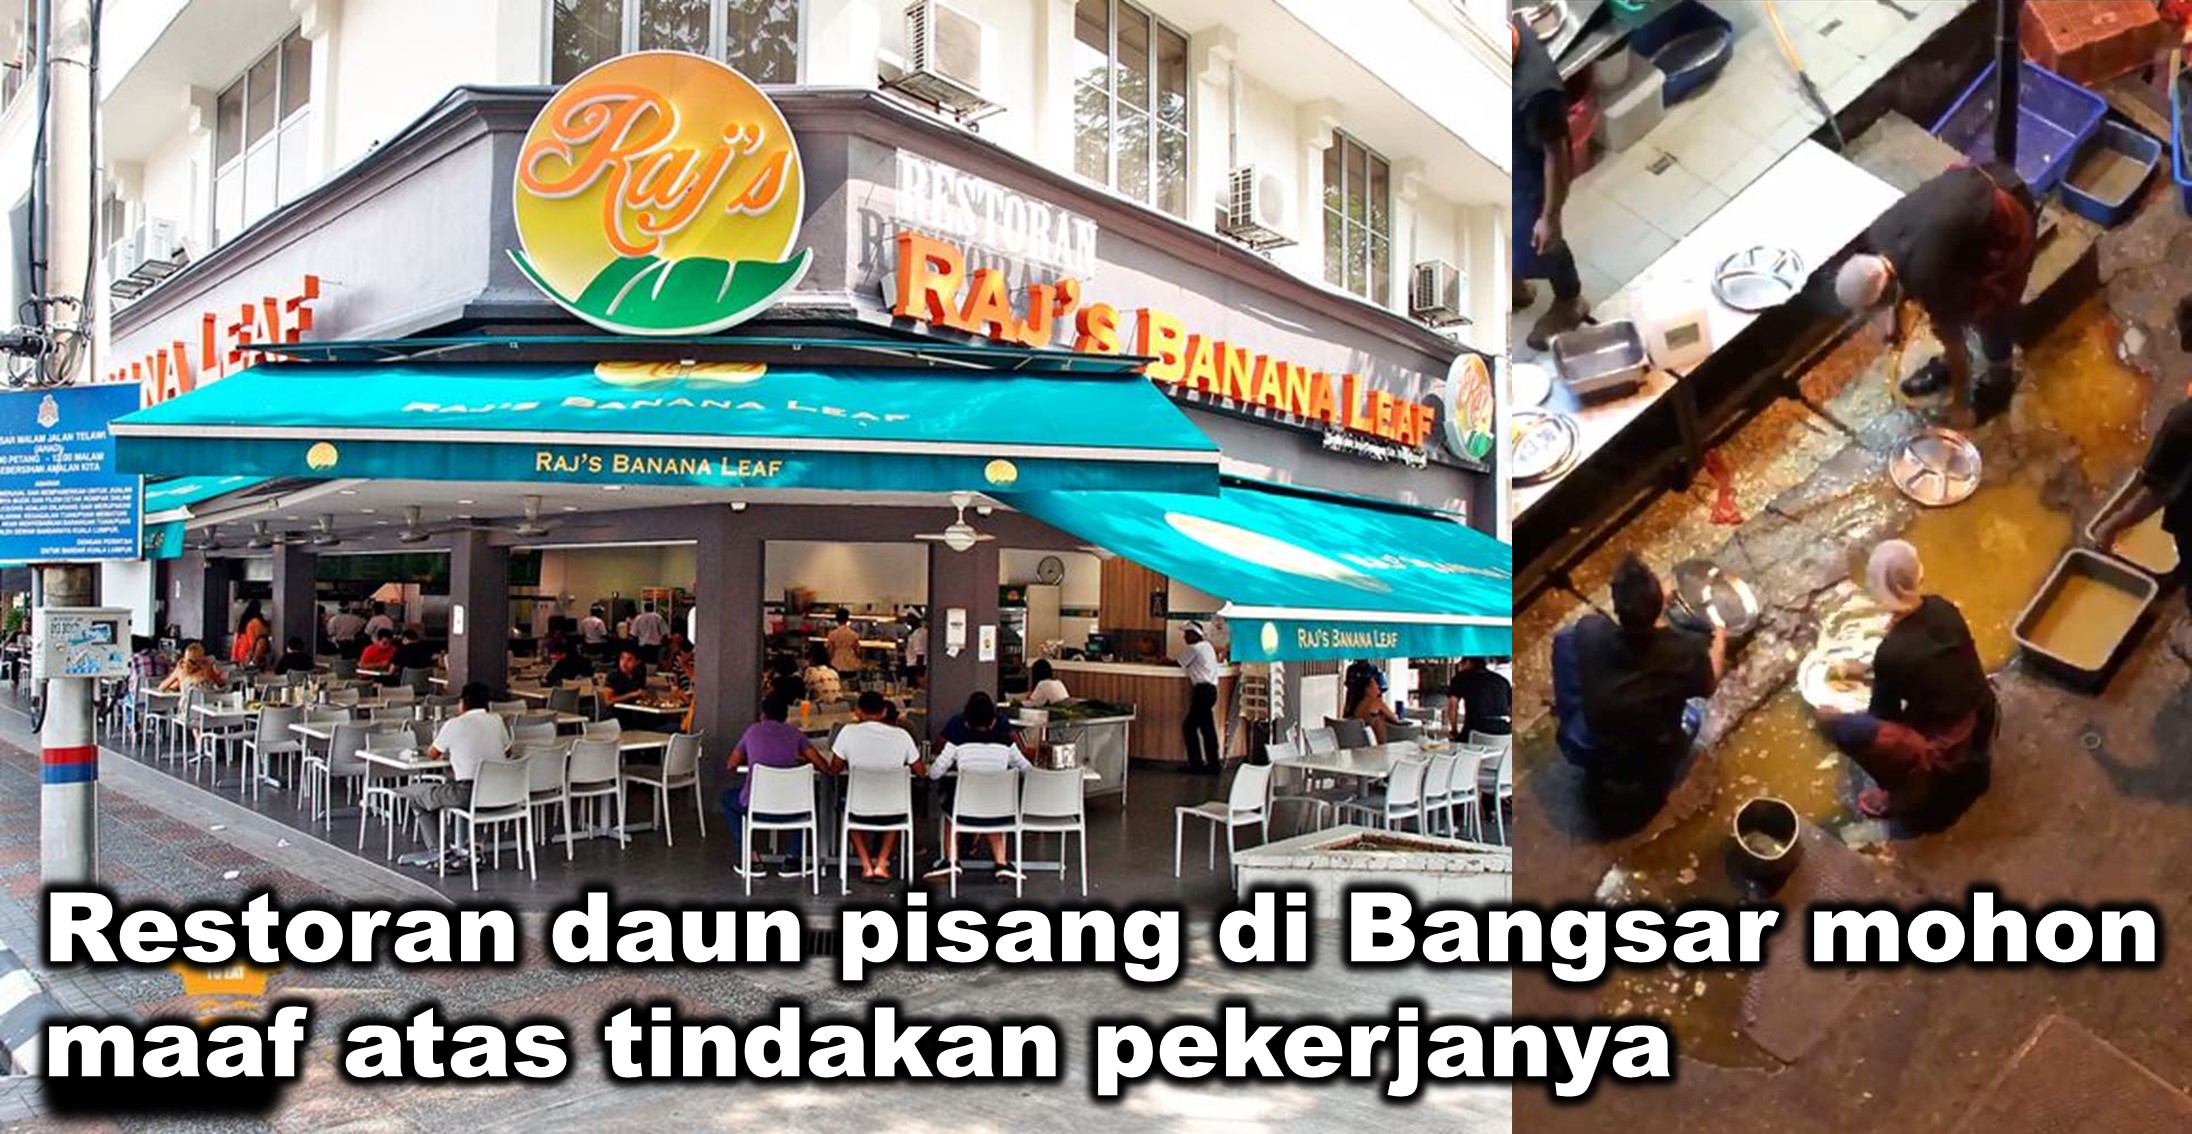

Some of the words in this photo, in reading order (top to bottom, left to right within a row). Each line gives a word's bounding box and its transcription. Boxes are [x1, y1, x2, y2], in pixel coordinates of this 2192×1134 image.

[519, 83, 794, 257] Raj's
[895, 147, 1099, 280] RESTORAN
[892, 230, 1121, 354] RAJ'S
[1136, 307, 1336, 426] BANANA
[1341, 373, 1436, 447] LEAF
[48, 432, 74, 443] JALAN
[535, 451, 603, 473] RAJ'S
[612, 453, 712, 476] BANANA
[721, 456, 783, 477] LEAF
[1298, 628, 1329, 648] RAJ'S
[1332, 629, 1372, 648] BANANA
[1374, 629, 1398, 648] LEAF
